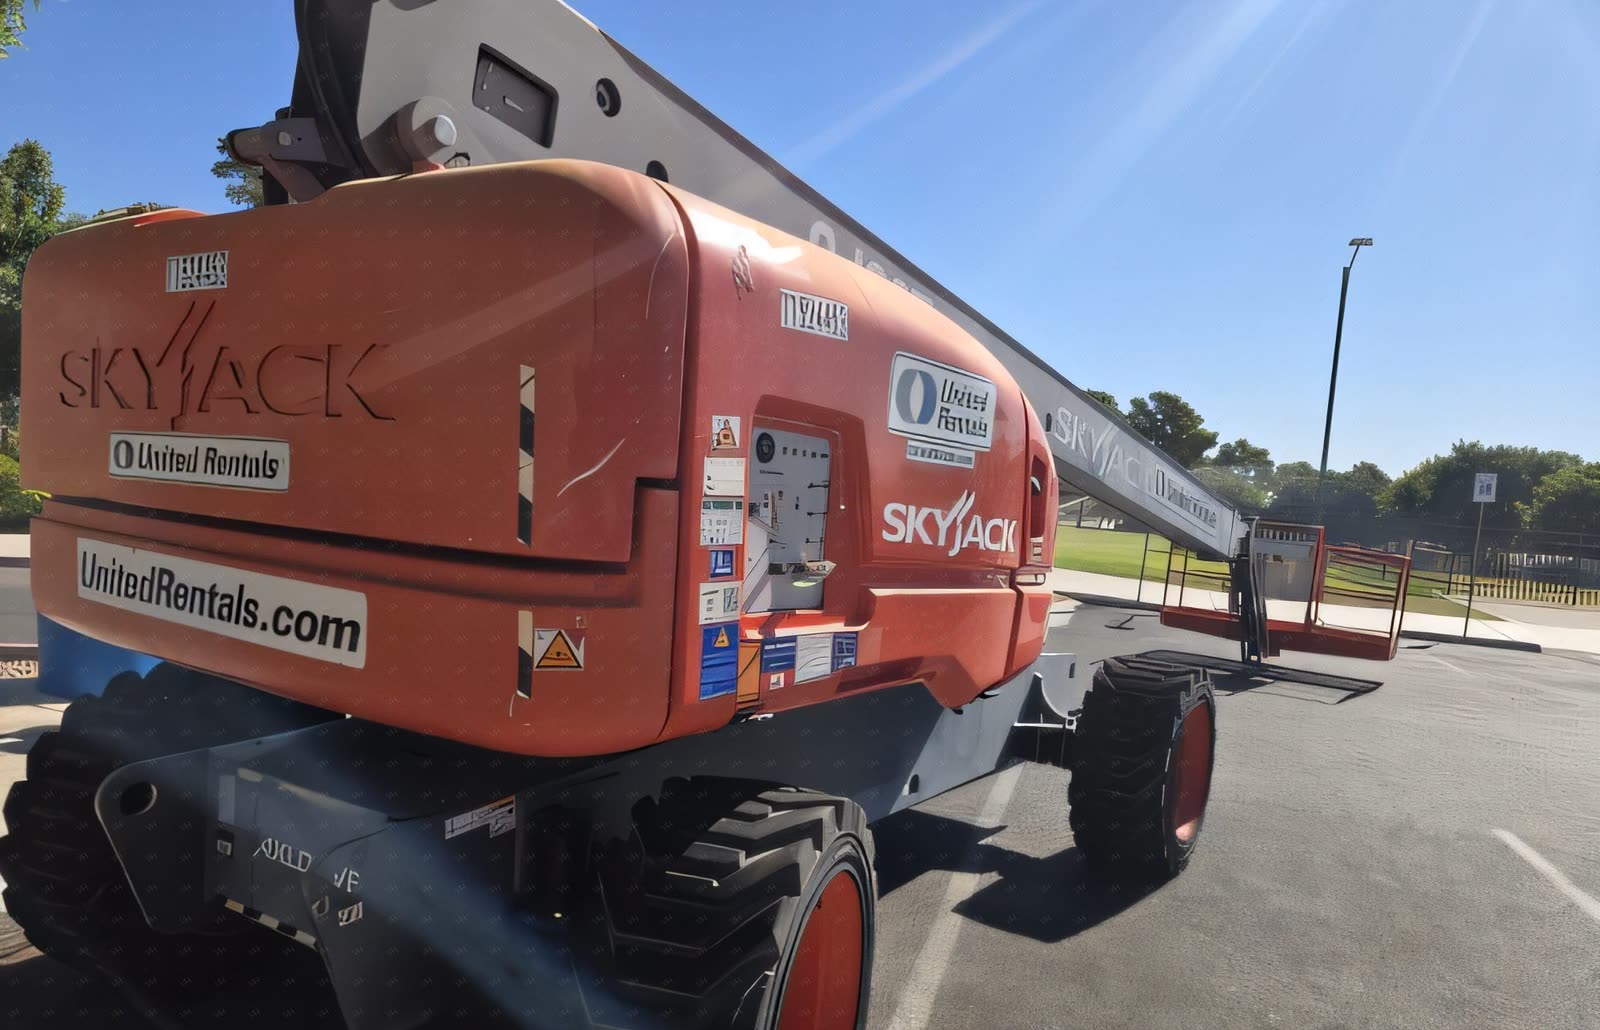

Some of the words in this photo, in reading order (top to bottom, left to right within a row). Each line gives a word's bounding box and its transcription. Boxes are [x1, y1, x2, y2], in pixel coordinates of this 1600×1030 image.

[58, 300, 397, 431] SKYJACK
[138, 442, 199, 473] United
[882, 489, 1017, 557] SKYJACK
[81, 551, 361, 652] UnitedRentals.com
